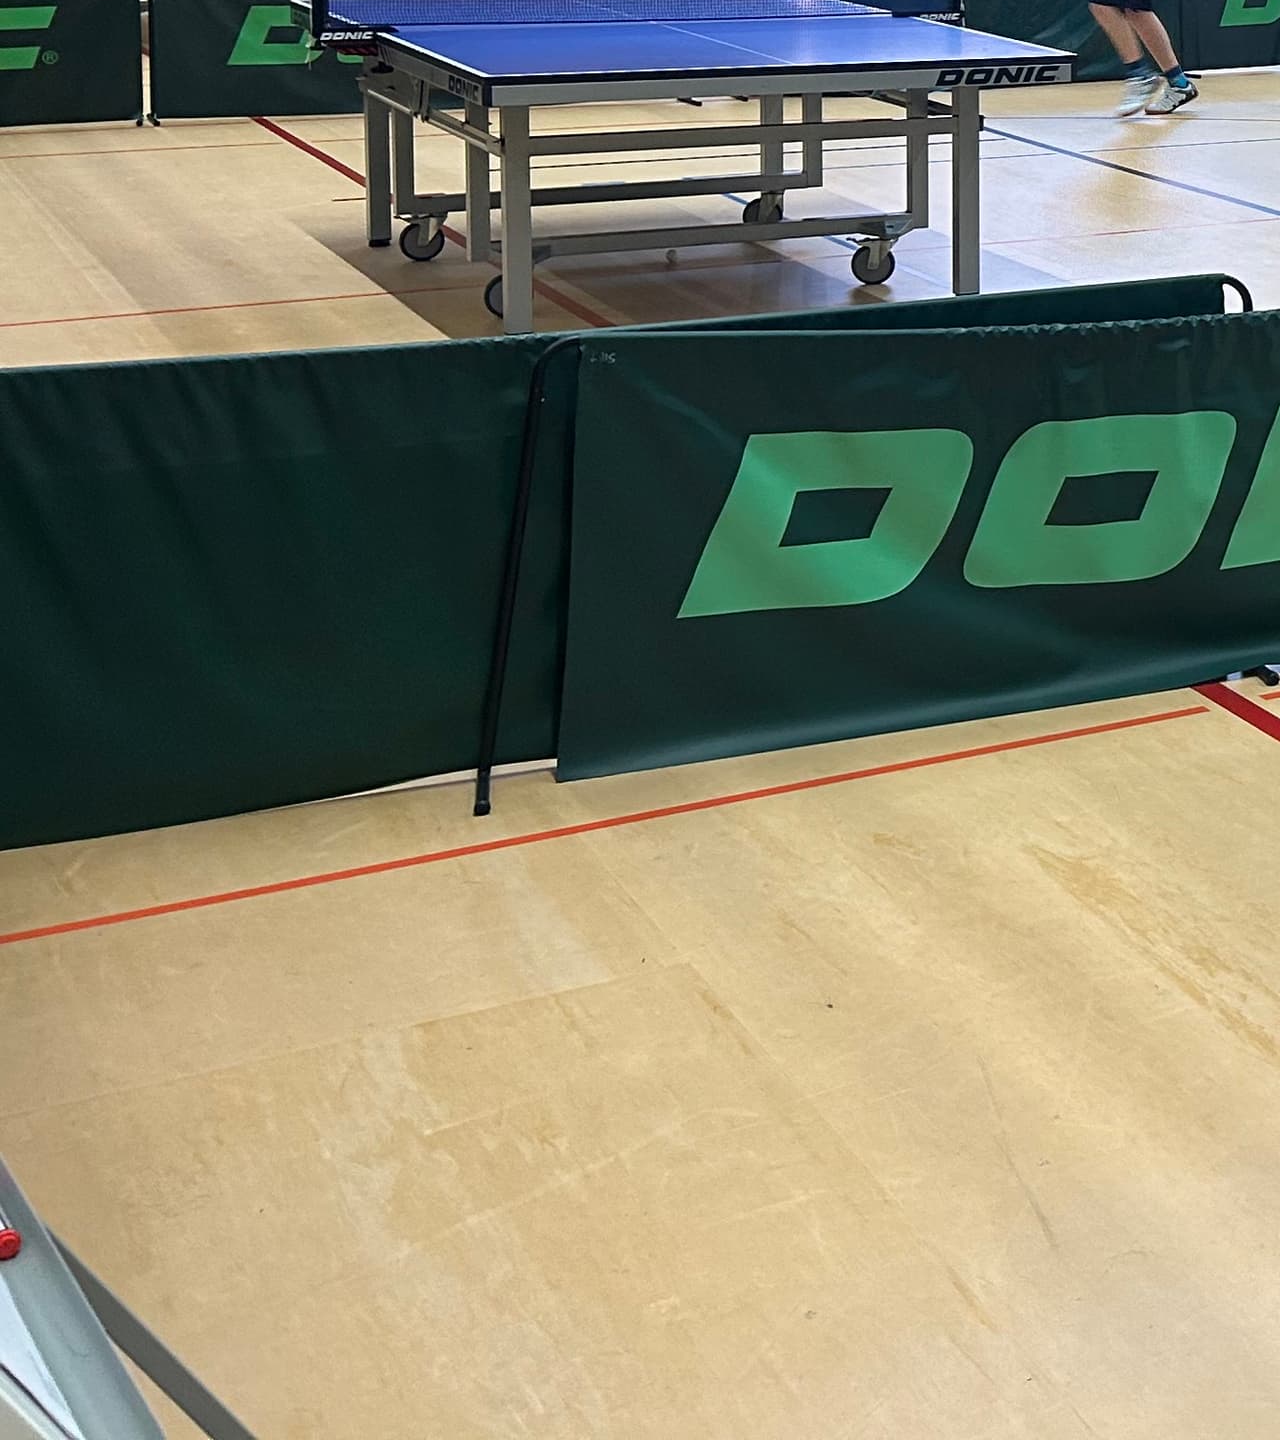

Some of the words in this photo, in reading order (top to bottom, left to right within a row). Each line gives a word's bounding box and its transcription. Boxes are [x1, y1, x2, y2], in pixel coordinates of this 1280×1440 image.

[320, 31, 373, 41] DONIC
[935, 65, 1060, 86] DONIC
[448, 75, 481, 102] DONIC
